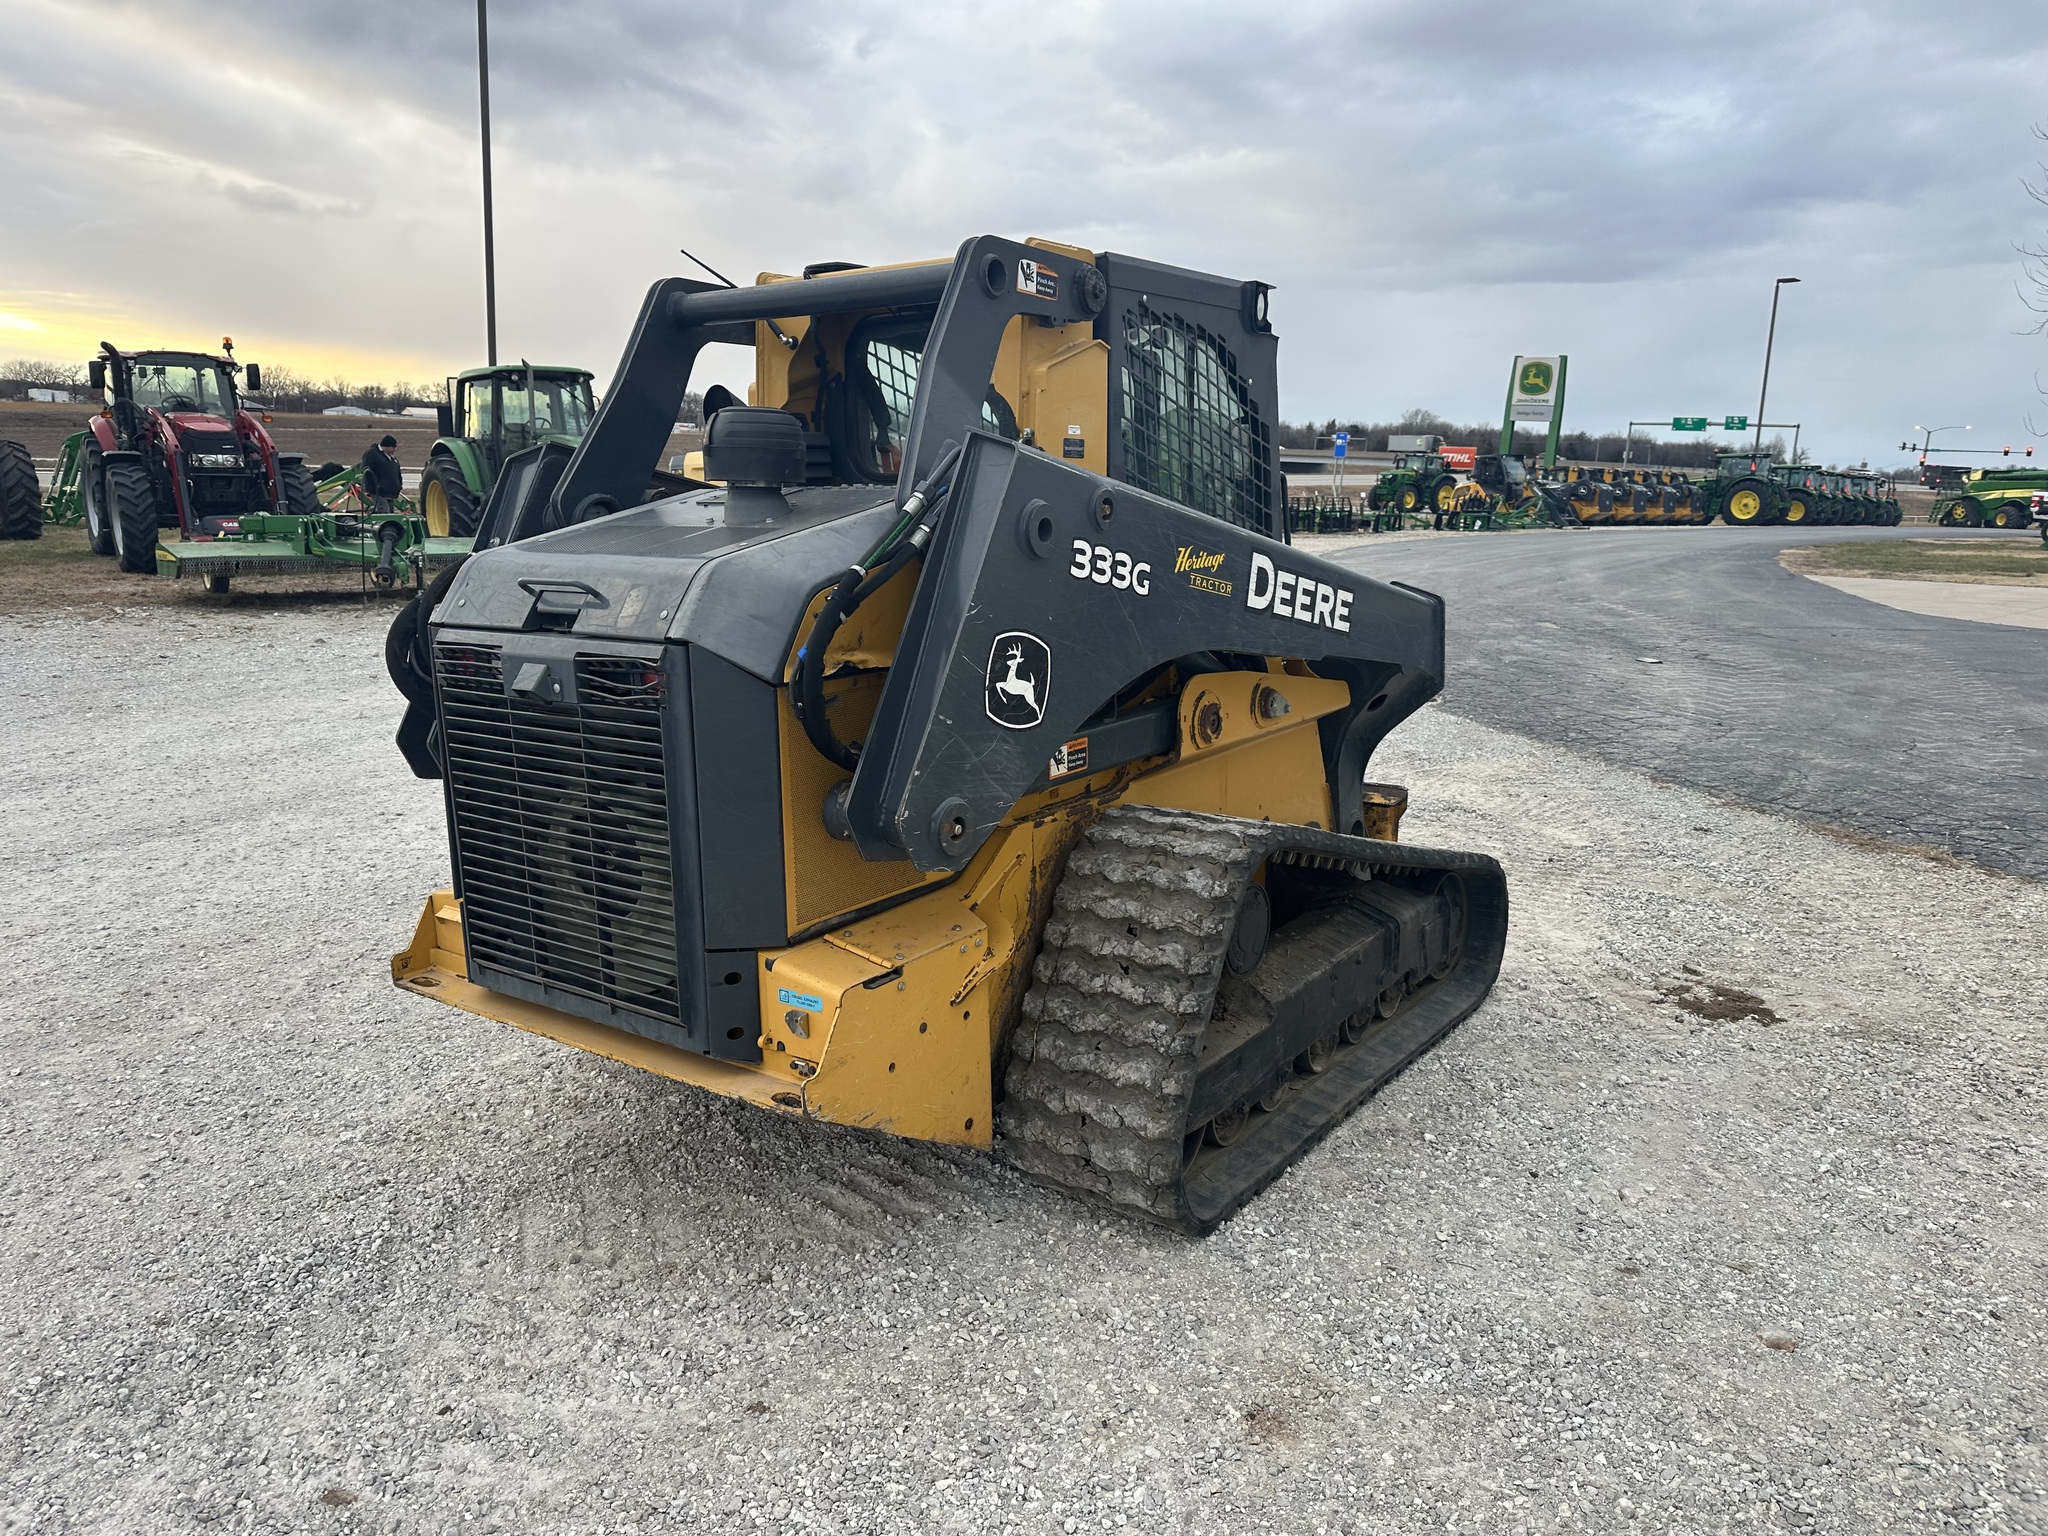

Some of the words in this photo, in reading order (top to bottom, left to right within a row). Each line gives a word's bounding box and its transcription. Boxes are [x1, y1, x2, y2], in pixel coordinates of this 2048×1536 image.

[1070, 539, 1151, 596] 333G
[1174, 545, 1226, 574] Heritage
[1190, 575, 1233, 595] TRACTOR
[1247, 552, 1354, 633] DEERE
